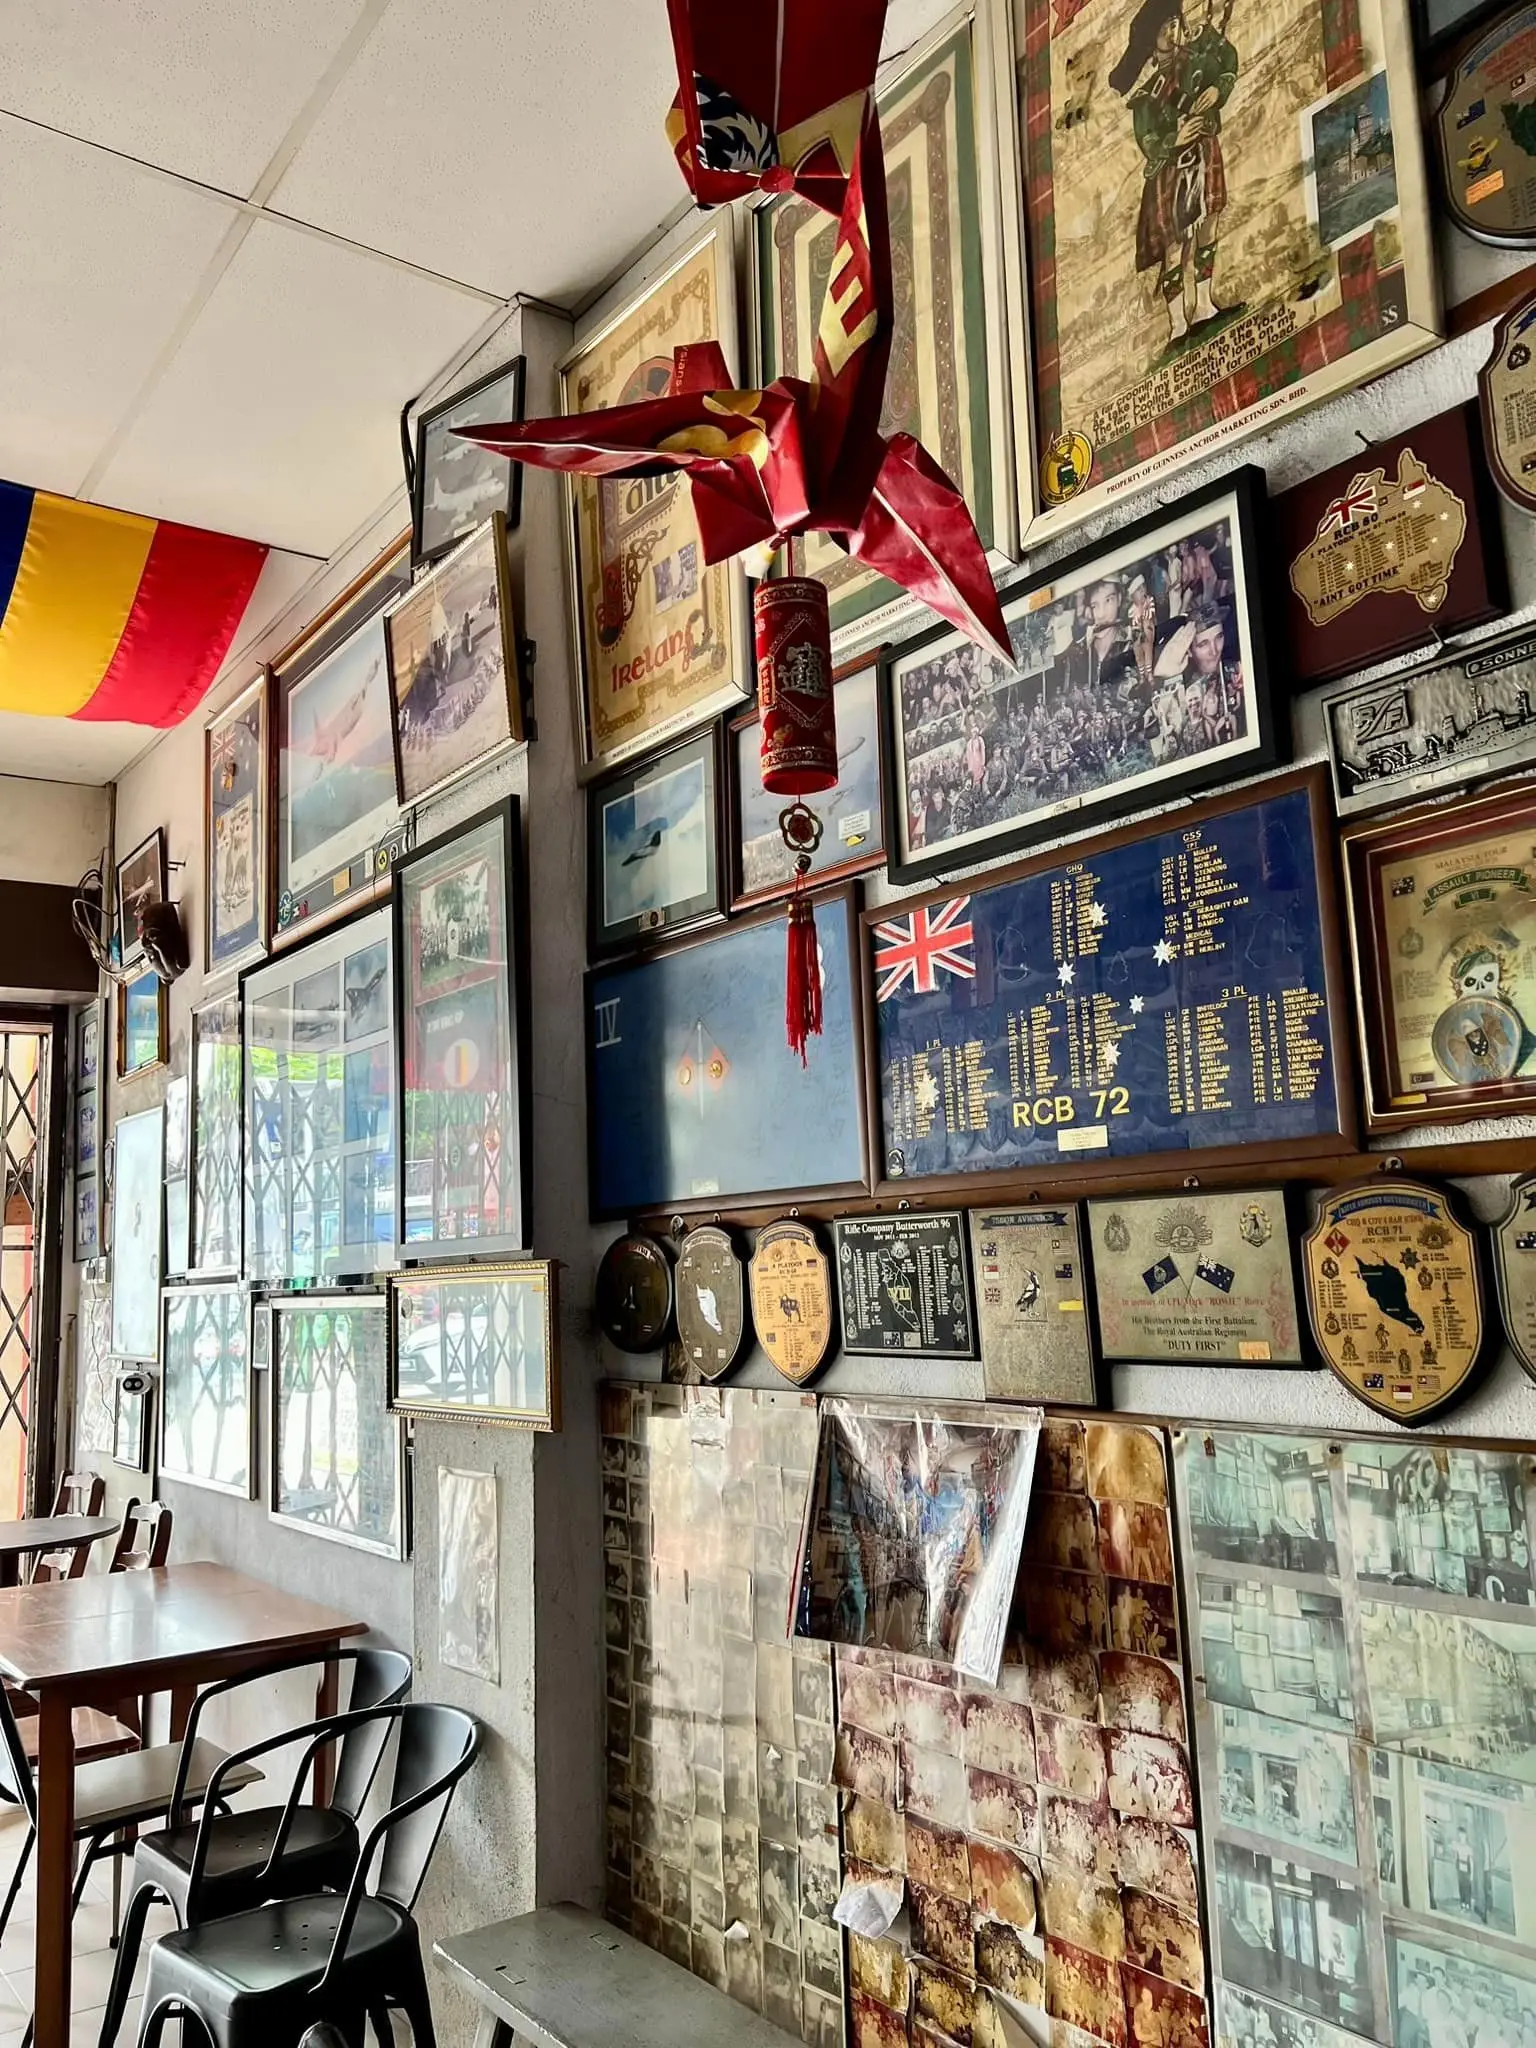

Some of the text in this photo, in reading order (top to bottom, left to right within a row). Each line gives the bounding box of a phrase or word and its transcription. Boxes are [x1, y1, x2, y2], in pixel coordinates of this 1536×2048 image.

[1093, 421, 1112, 438] The
[1114, 414, 1127, 428] far
[1133, 390, 1170, 416] Coolins
[1173, 379, 1190, 394] are
[1232, 337, 1255, 358] love
[1260, 325, 1274, 340] on
[1277, 311, 1296, 329] me
[1094, 434, 1107, 448] As
[1109, 421, 1130, 443] step
[1157, 398, 1174, 413] the
[1178, 369, 1222, 402] sunlight
[1226, 355, 1242, 372] for
[1245, 344, 1263, 363] my
[1267, 320, 1298, 346] load.
[1101, 403, 1114, 417] far
[1160, 370, 1169, 381] is
[1208, 337, 1225, 353] me
[1108, 403, 1130, 421] take
[1154, 380, 1170, 398] my
[1173, 354, 1215, 382] cromak
[1218, 343, 1230, 356] to
[1233, 328, 1253, 348] the
[1106, 472, 1142, 494] PROPERTY
[1142, 465, 1153, 476] OF
[1153, 447, 1188, 471] GUINNESS
[1188, 431, 1220, 454] ANCHOR
[1220, 406, 1269, 436] MARKETING
[1334, 521, 1359, 540] RCB
[1317, 535, 1354, 555] PLATOON
[1347, 578, 1371, 592] GOT
[1434, 854, 1480, 869] MALAYSIA
[1484, 846, 1508, 858] TOUR
[1433, 869, 1516, 898] ASSAULT PIONEER
[1046, 990, 1066, 1001] 2 PL
[1221, 986, 1247, 998] 3 PL
[1013, 1086, 1130, 1128] RCB 72
[844, 1218, 951, 1235] Rifle Company Butterworth 96
[1367, 1226, 1390, 1236] RCB
[1174, 1316, 1190, 1324] from
[1204, 1316, 1222, 1324] First
[1157, 1327, 1176, 1337] Royal
[1178, 1327, 1212, 1336] Australian
